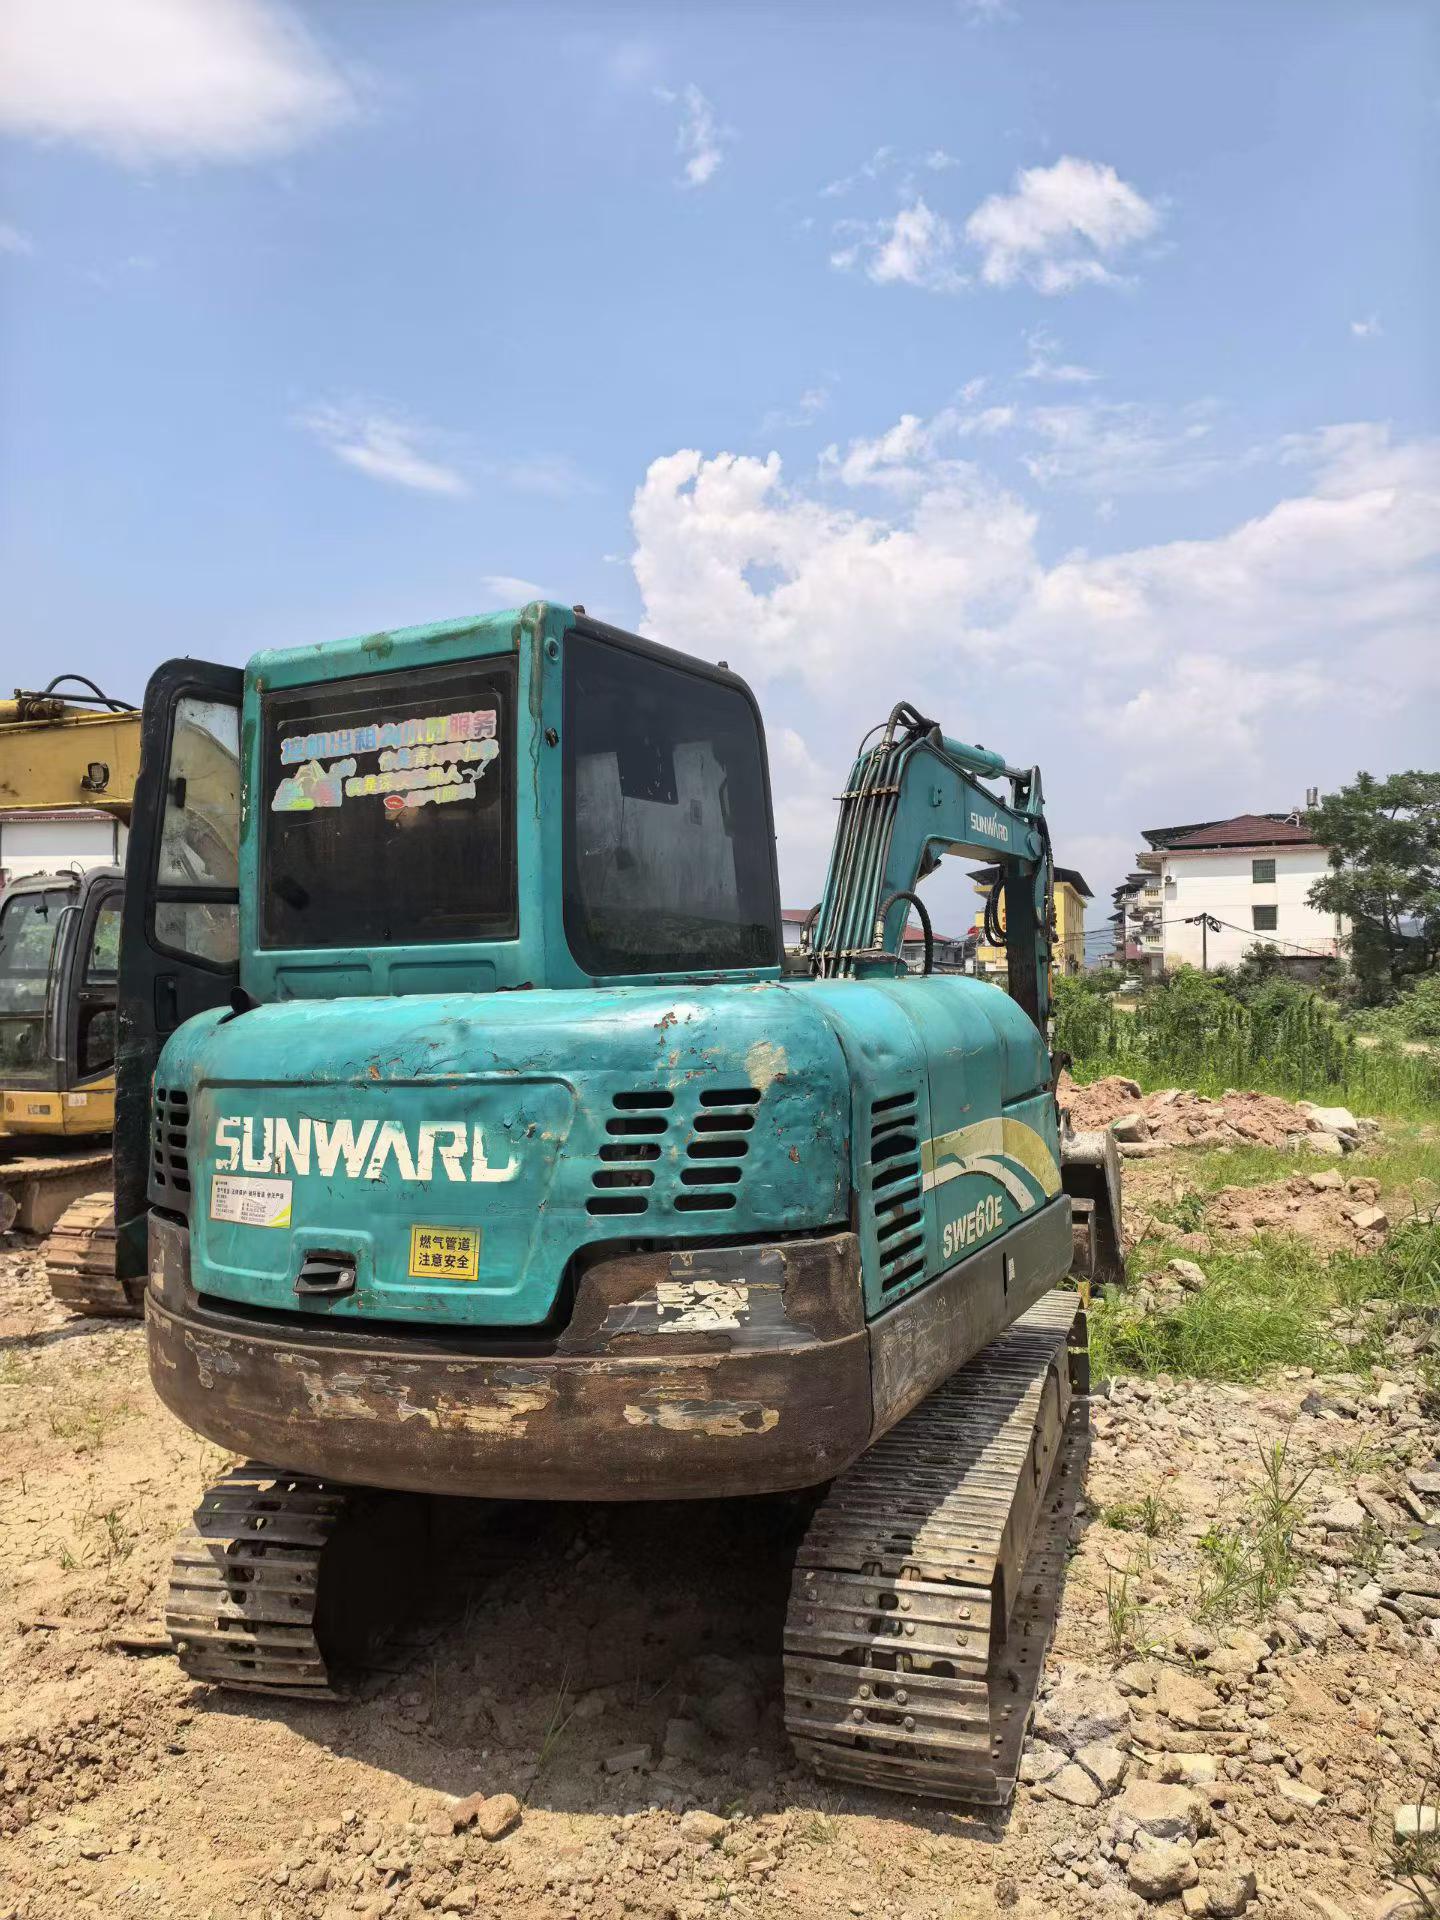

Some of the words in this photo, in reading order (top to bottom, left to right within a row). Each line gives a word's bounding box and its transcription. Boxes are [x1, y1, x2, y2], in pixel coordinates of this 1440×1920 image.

[970, 812, 1008, 842] SUNWARD
[215, 1116, 523, 1182] SUNWARD
[943, 1194, 1003, 1259] SWE60E
[419, 1234, 471, 1251] 燃气管道
[418, 1252, 469, 1269] 注意安全
